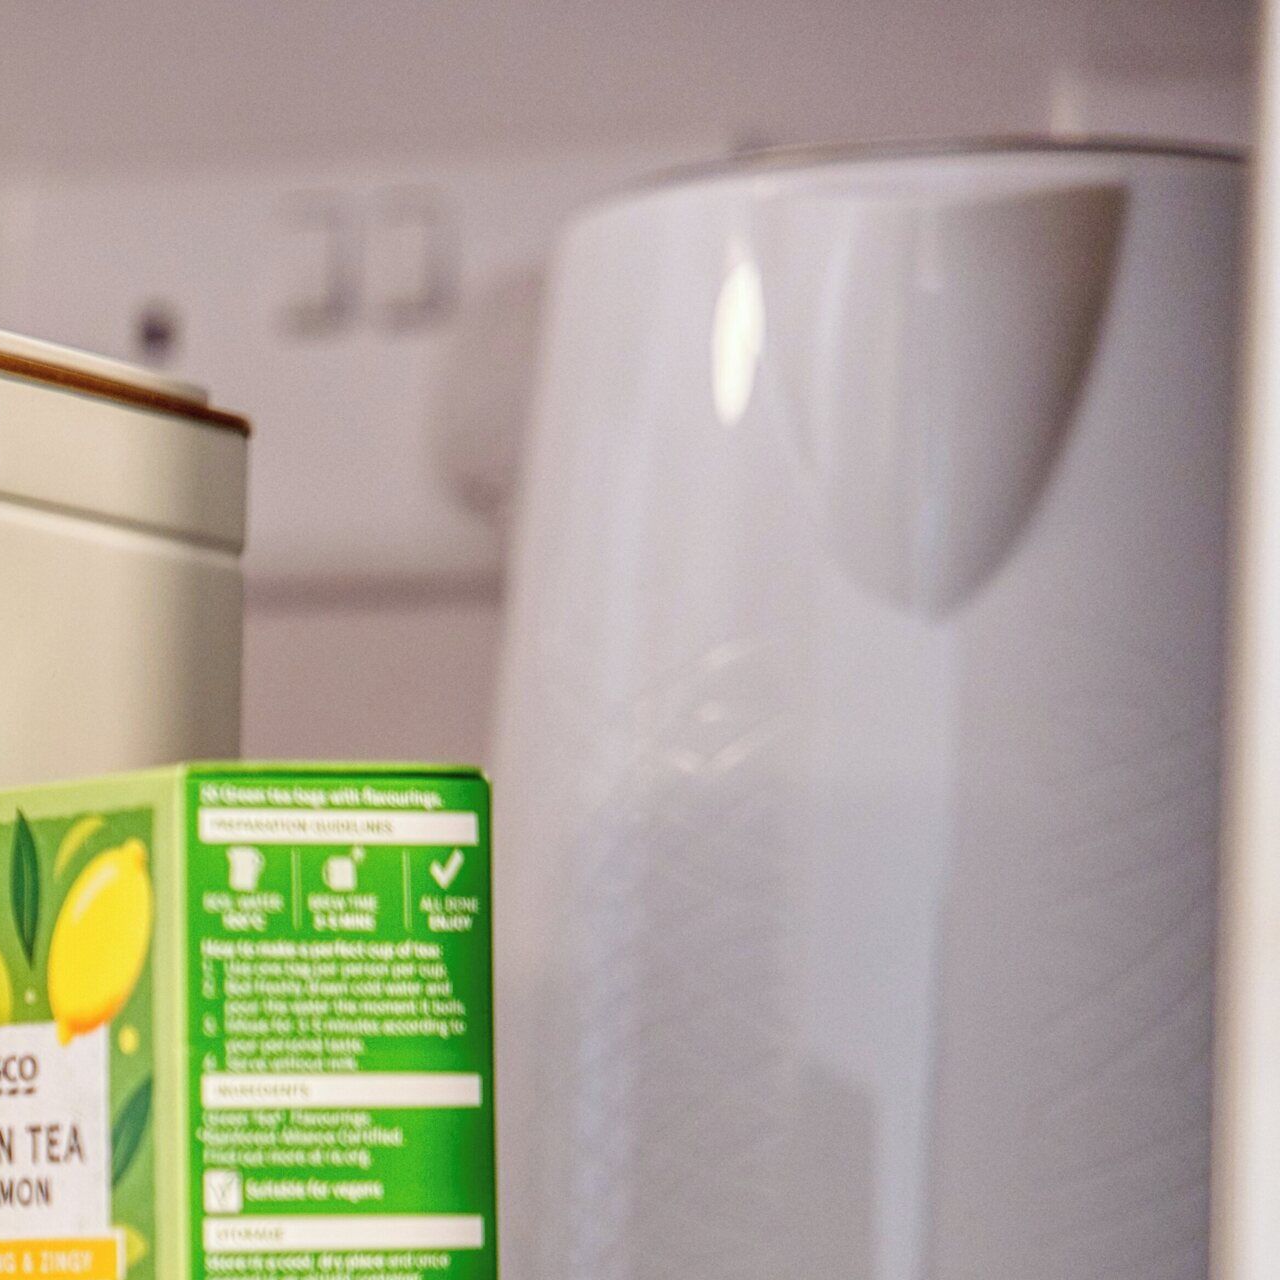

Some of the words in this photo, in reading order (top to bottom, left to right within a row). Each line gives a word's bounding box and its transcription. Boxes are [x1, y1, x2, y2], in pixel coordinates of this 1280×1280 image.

[27, 1124, 85, 1164] TEA
[23, 1253, 33, 1273] &
[41, 1251, 95, 1273] ZINGY
